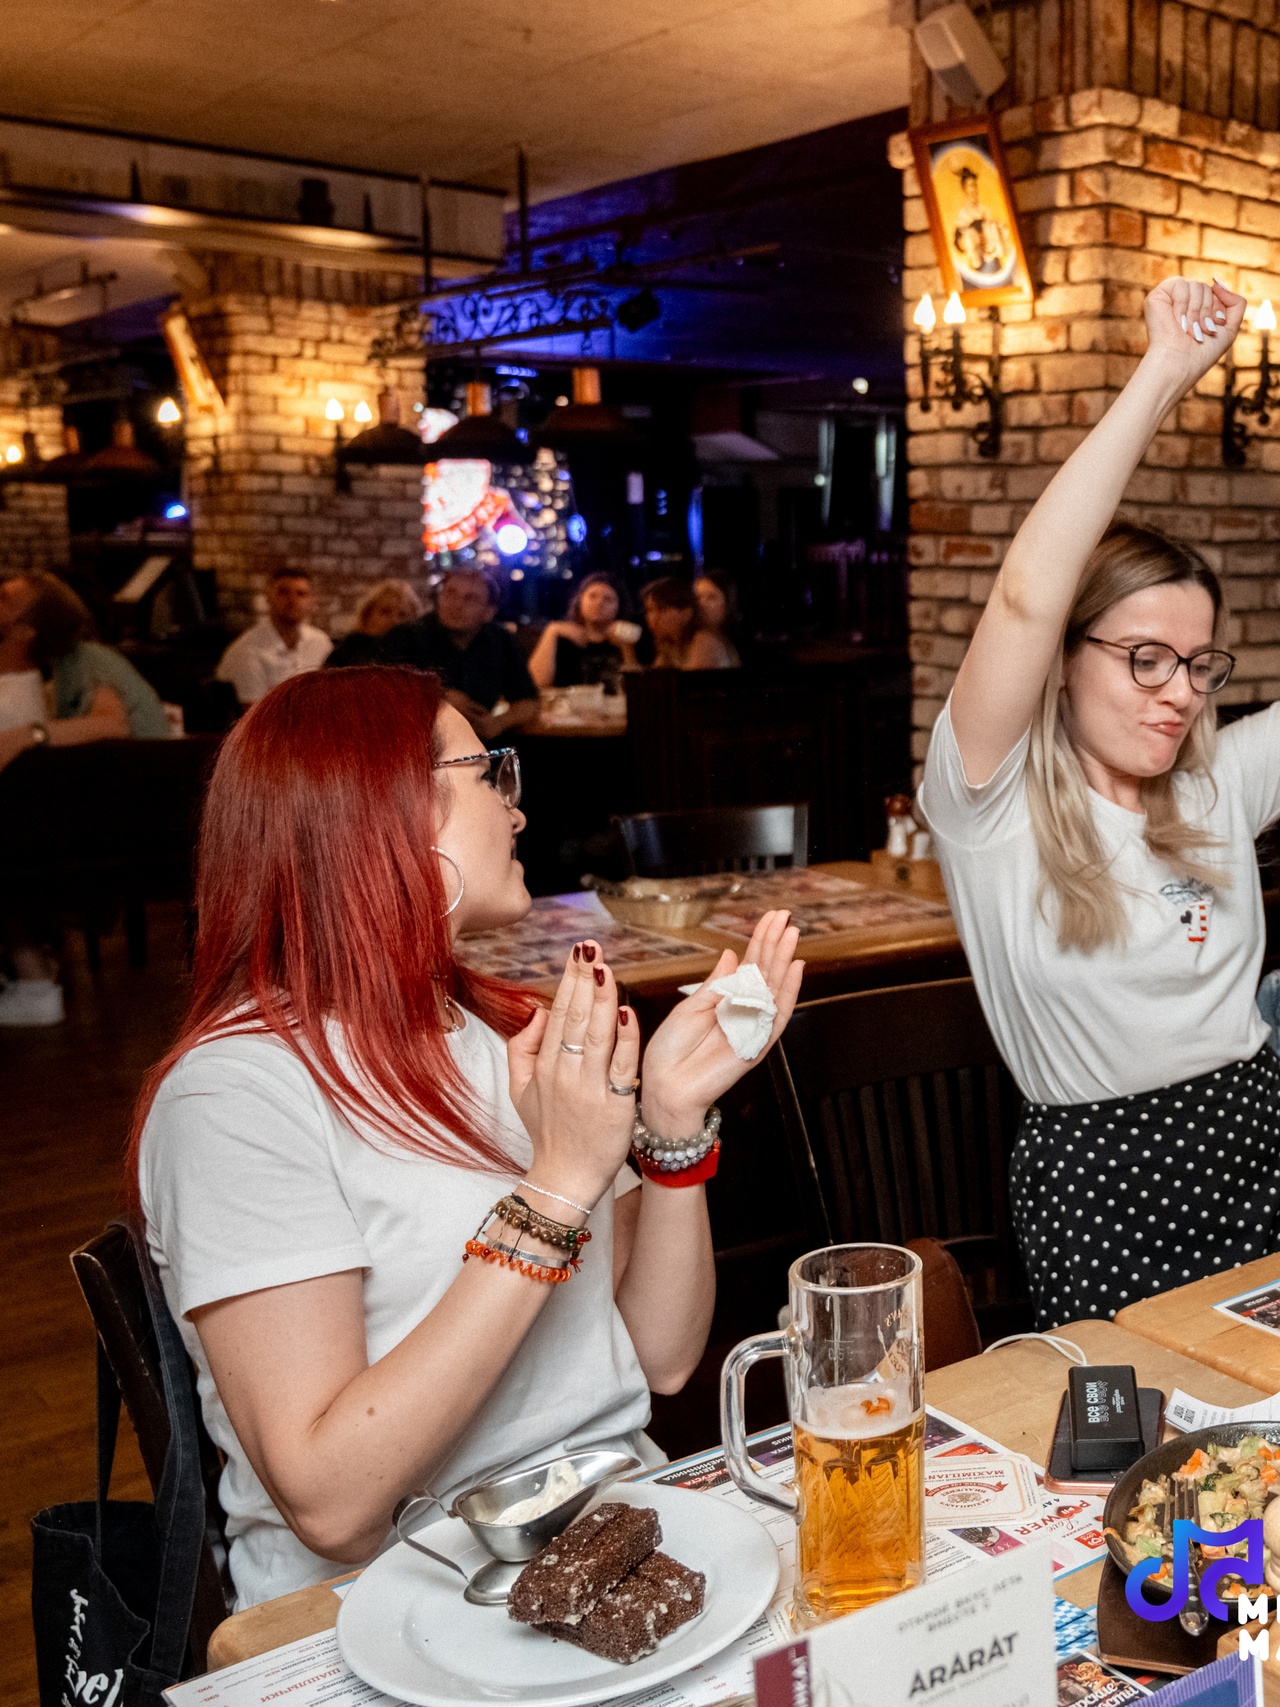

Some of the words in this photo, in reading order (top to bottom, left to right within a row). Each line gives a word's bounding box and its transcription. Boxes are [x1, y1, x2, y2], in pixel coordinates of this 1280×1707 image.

[684, 1470, 722, 1487] АВГУСТА
[689, 1465, 716, 1477] ДЕНЬ
[907, 1631, 1019, 1699] ARARAT
[260, 1667, 342, 1703] ШАШЛЫЧКИ
